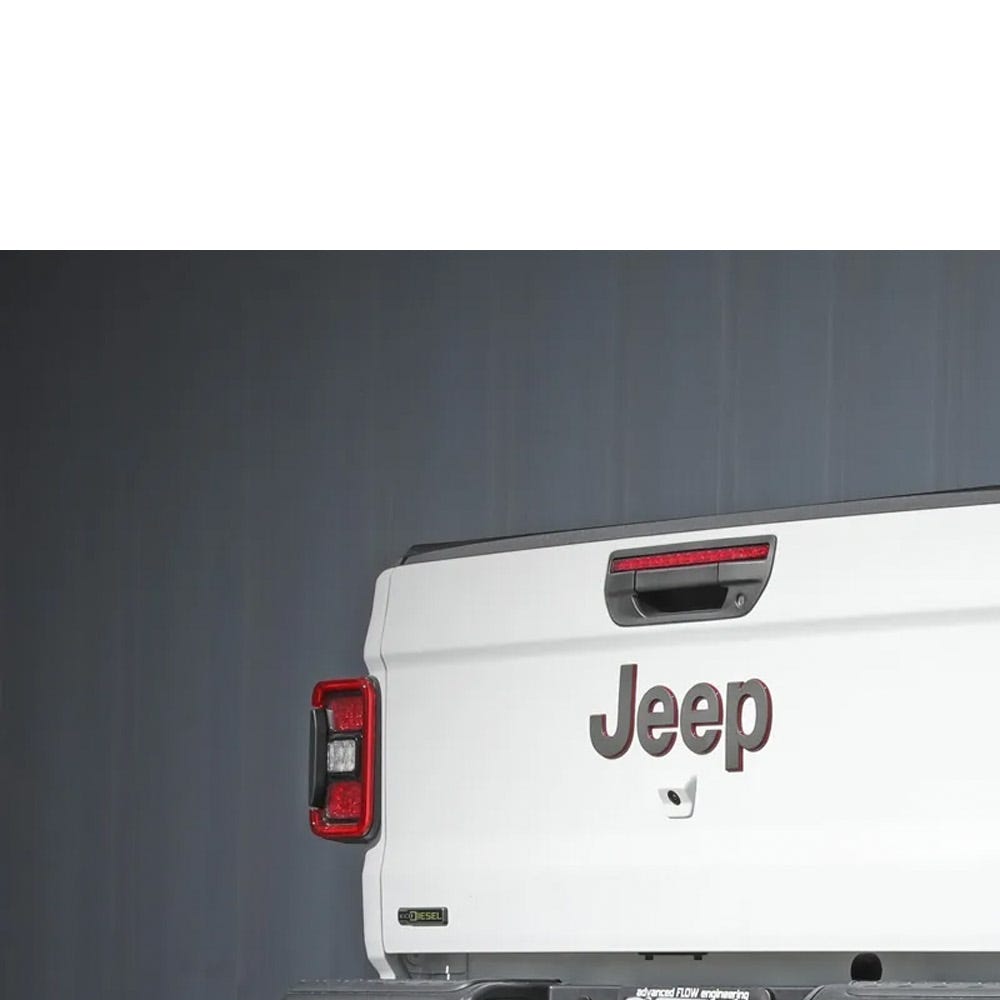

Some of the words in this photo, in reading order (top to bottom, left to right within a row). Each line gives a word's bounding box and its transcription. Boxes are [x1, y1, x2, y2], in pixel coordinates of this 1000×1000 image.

[589, 664, 773, 772] Jeep
[636, 987, 675, 998] advanced
[675, 988, 700, 998] FLOW
